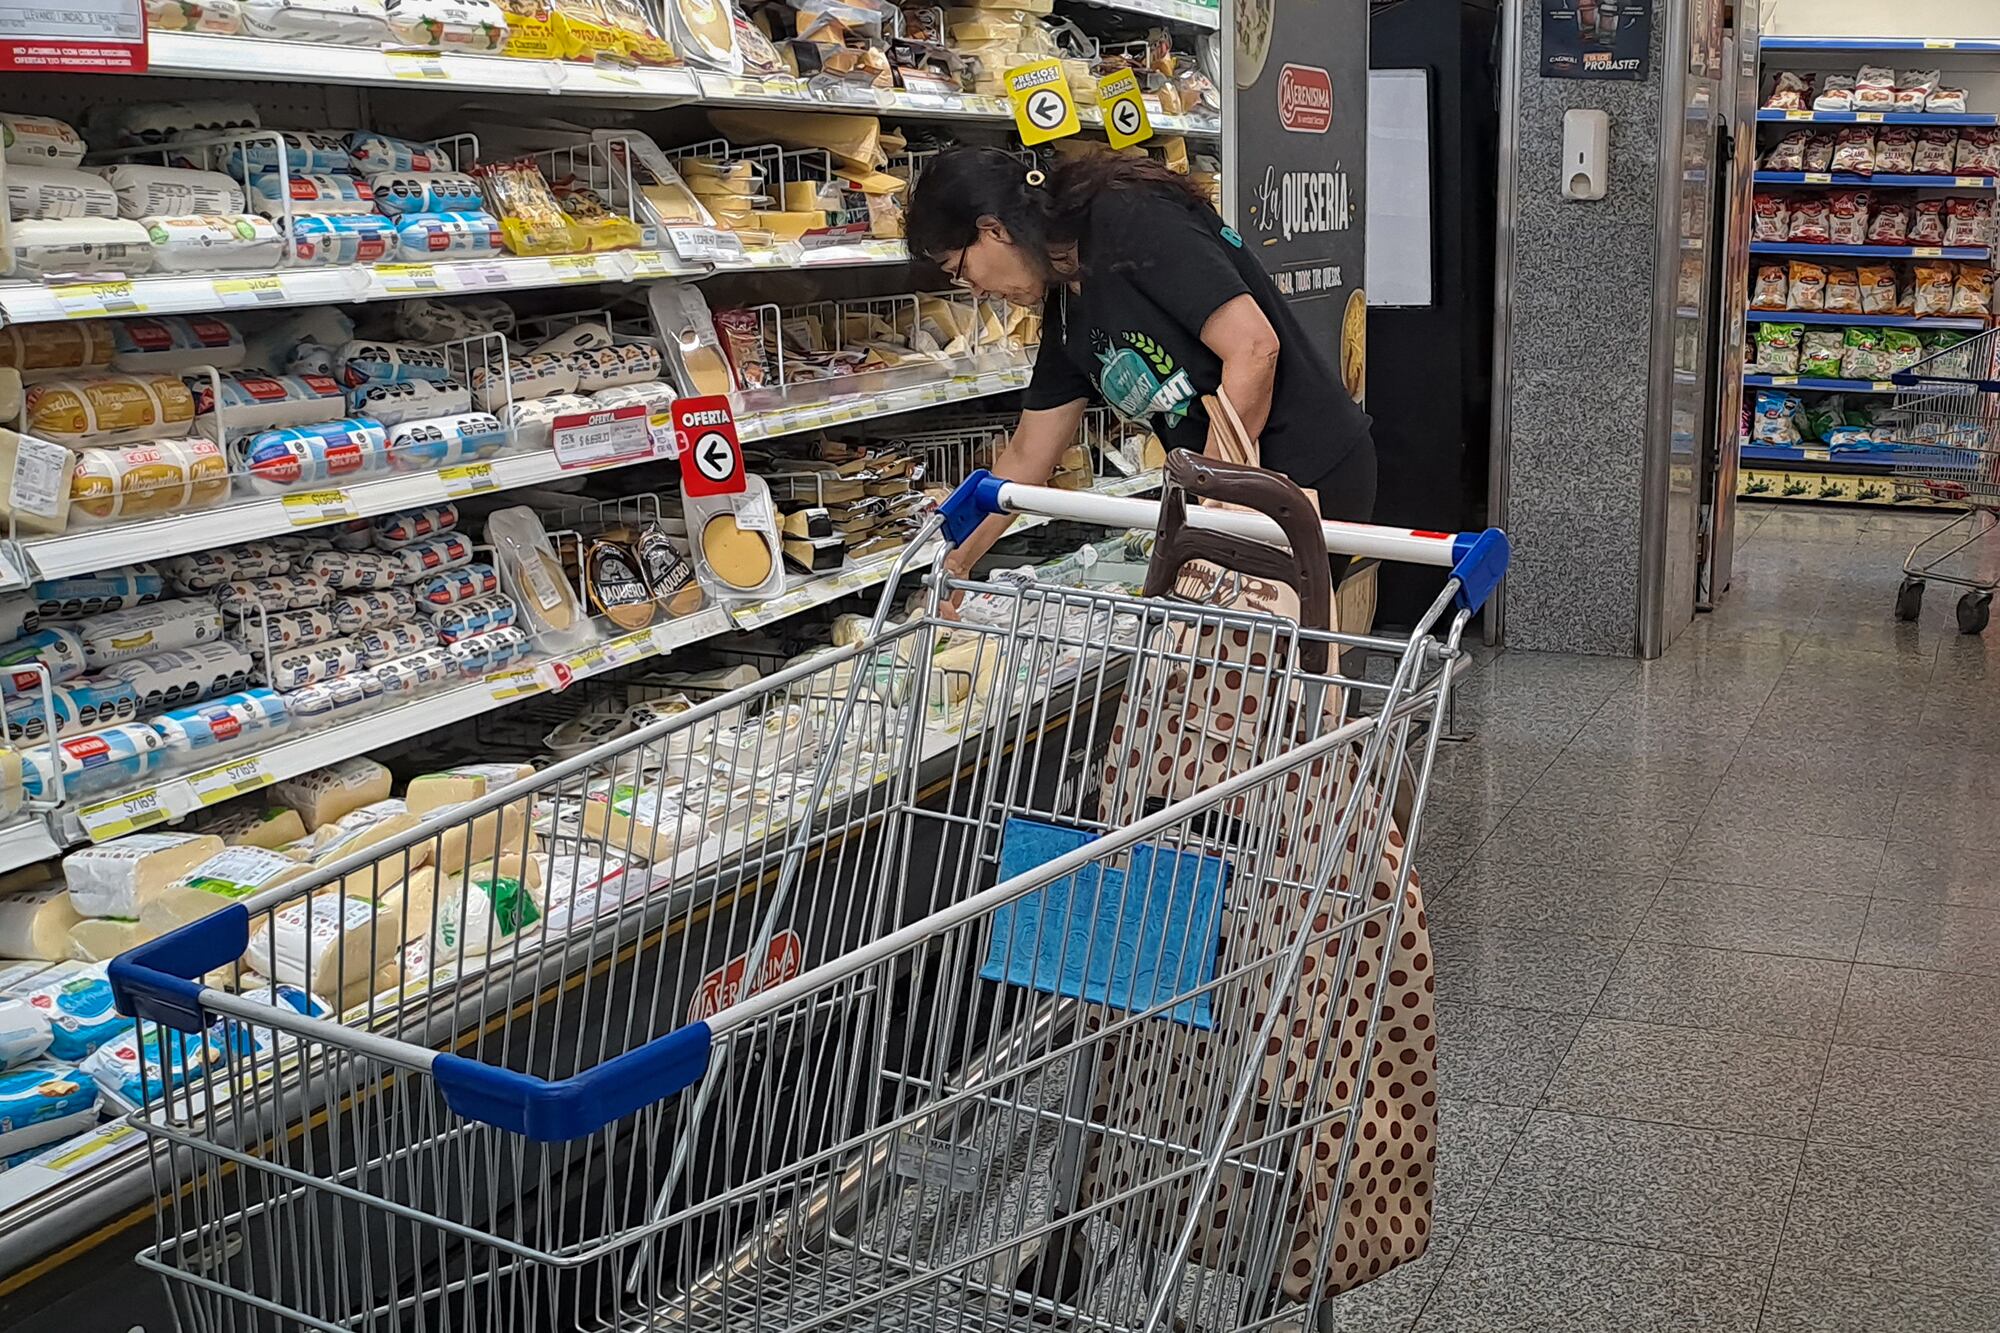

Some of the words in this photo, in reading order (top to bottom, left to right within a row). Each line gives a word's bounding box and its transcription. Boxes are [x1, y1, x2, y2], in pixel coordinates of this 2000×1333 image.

[1583, 59, 1640, 71] PROBASTE?
[1282, 160, 1349, 241] QUESERÍA
[684, 409, 730, 427] OFERTA
[599, 582, 646, 600] VAQUERO
